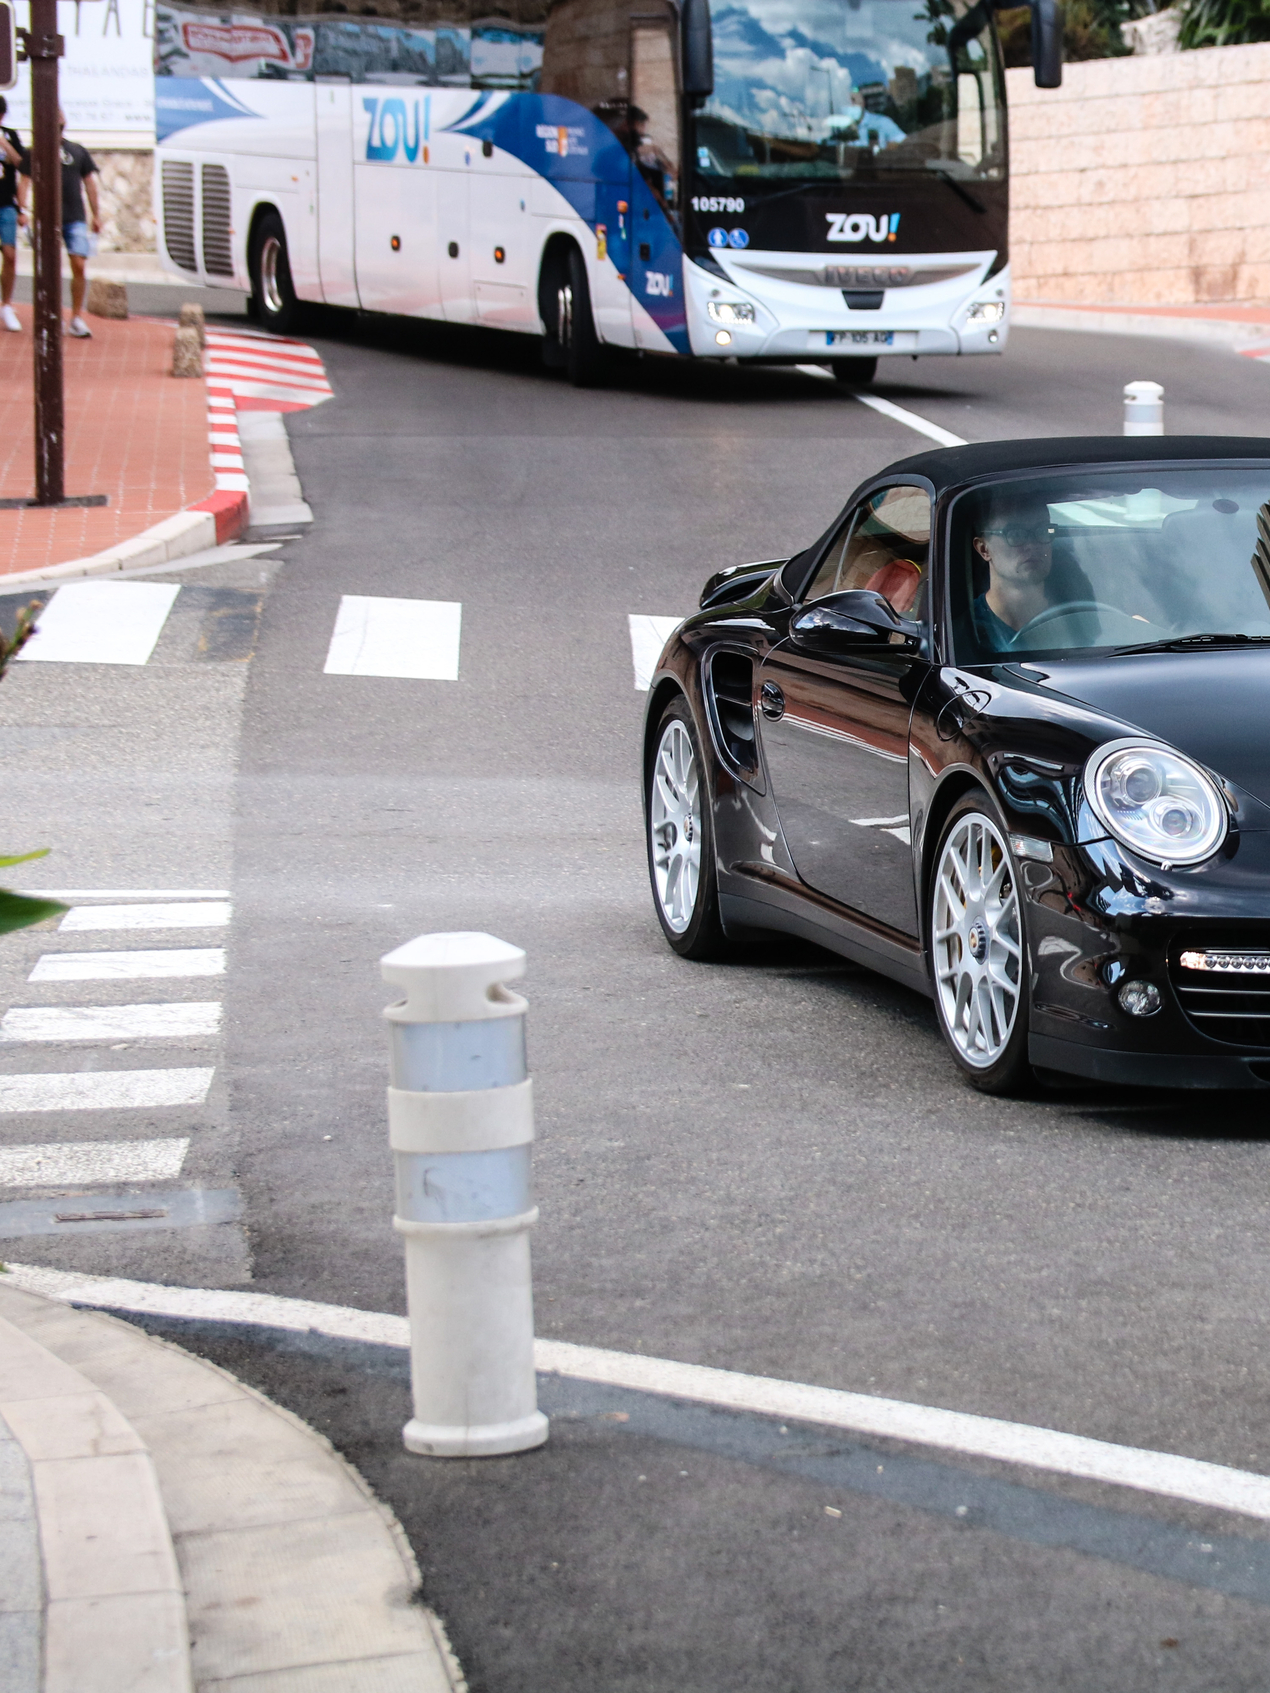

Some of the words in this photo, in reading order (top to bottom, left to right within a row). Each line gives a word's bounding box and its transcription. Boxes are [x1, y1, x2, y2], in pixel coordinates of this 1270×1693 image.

[362, 95, 431, 165] ZOU!
[691, 196, 745, 212] 105790
[825, 212, 901, 242] ZOU!
[645, 270, 674, 297] ZOU!
[825, 265, 909, 283] IVECO
